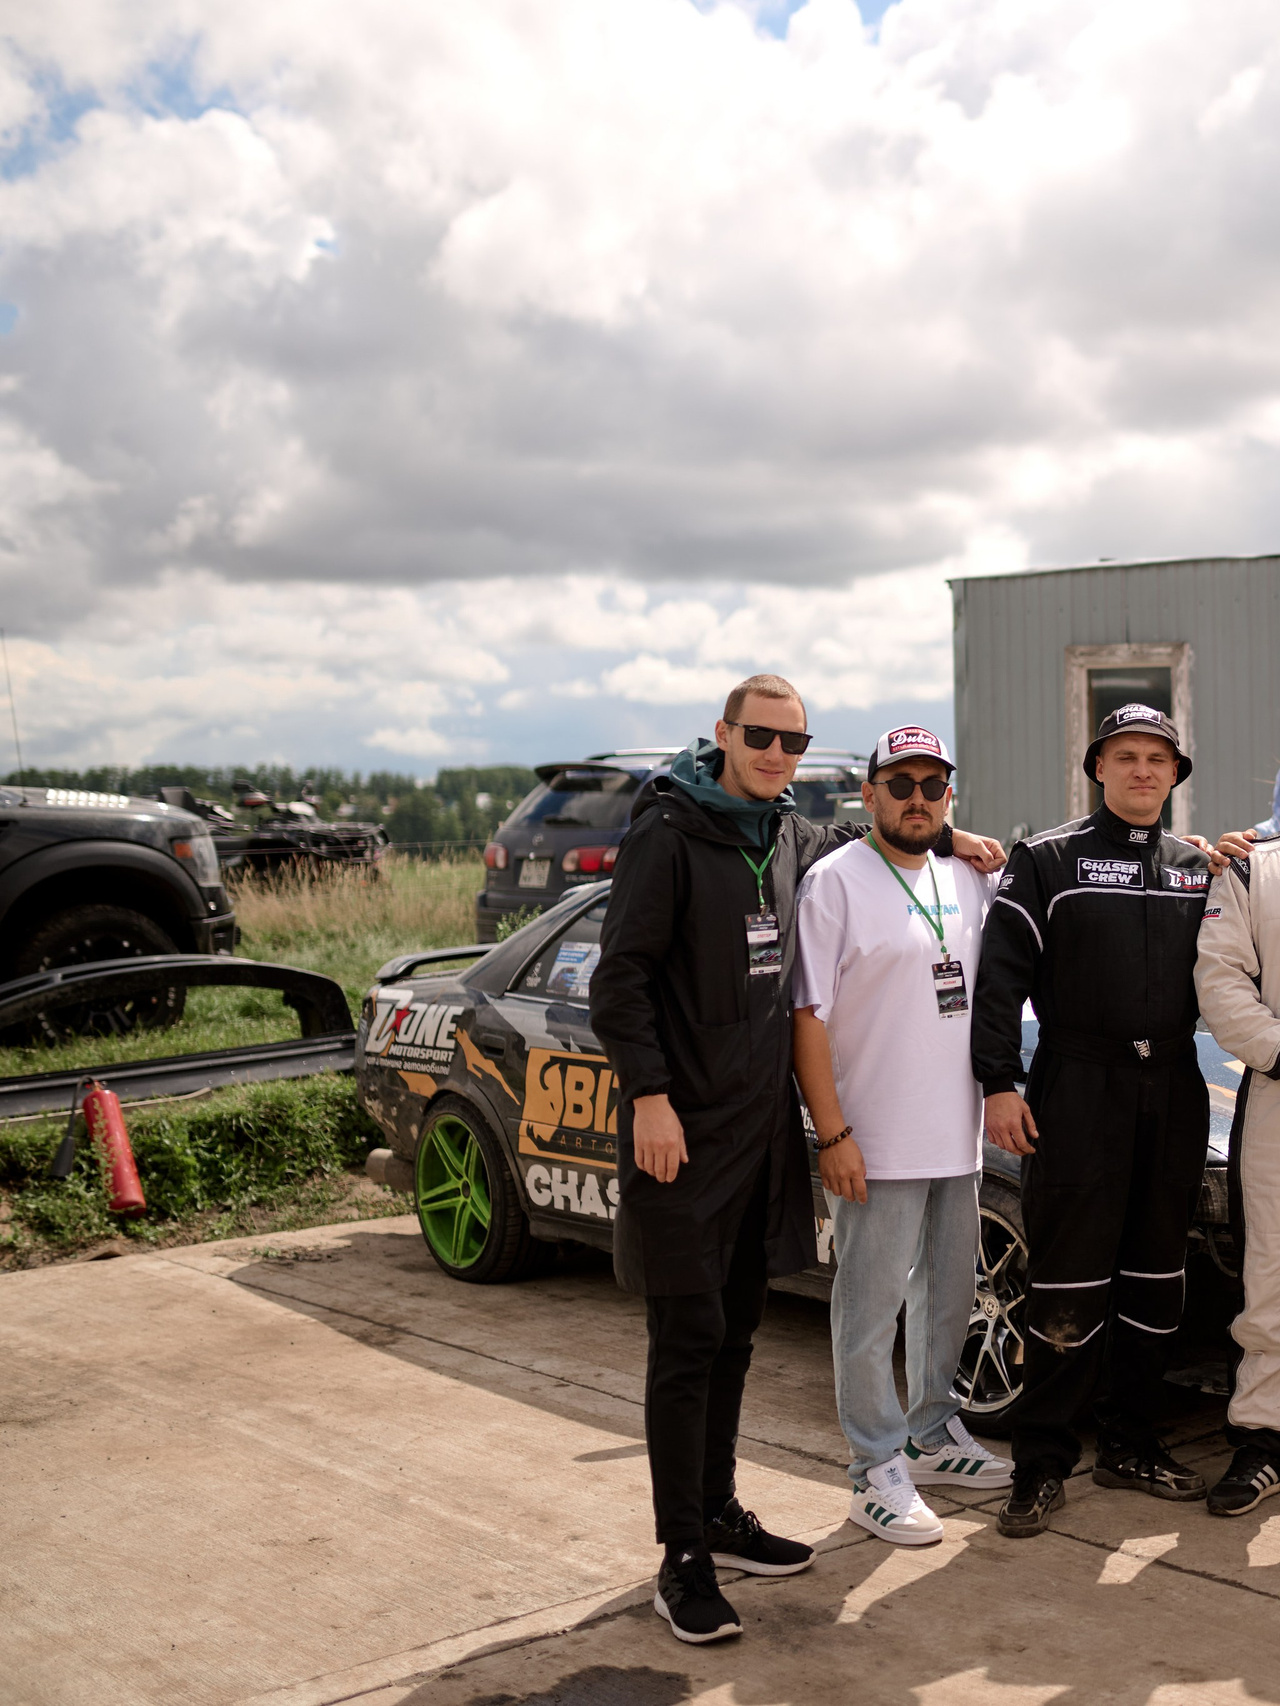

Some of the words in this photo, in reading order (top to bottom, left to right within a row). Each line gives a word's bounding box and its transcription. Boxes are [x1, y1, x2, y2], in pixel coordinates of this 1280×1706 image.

[891, 732, 937, 747] Dubai
[1129, 832, 1148, 841] OMP
[1081, 861, 1139, 875] CHASER
[1088, 872, 1132, 884] CREW
[388, 1044, 455, 1063] MOTORSPORT
